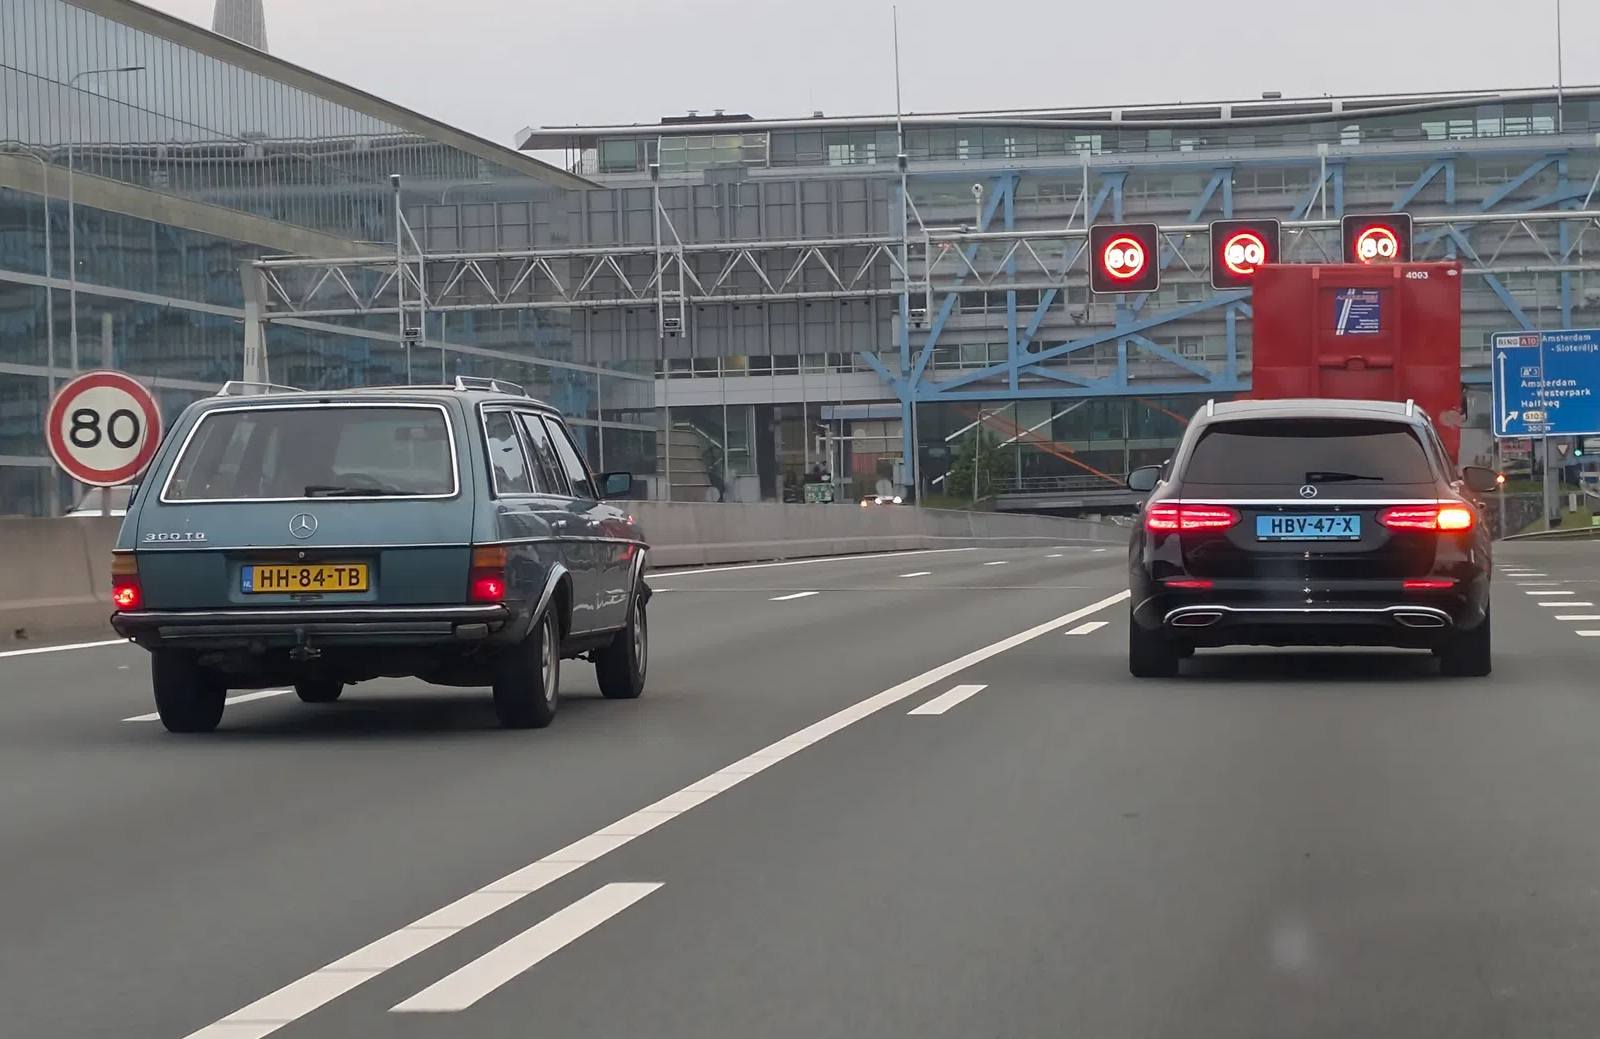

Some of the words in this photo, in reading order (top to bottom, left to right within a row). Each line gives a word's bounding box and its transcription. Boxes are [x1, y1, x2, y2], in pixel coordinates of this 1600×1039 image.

[1227, 244, 1260, 264] 80
[1361, 238, 1394, 257] 80
[1108, 248, 1144, 269] 80
[1520, 337, 1537, 345] A10
[1542, 334, 1591, 343] Amsterdam
[1520, 379, 1577, 388] Amsterdam
[70, 408, 140, 449] 80
[1271, 518, 1353, 533] HBV-47-X
[145, 533, 181, 541] 300
[260, 568, 360, 588] HH-84-TB
